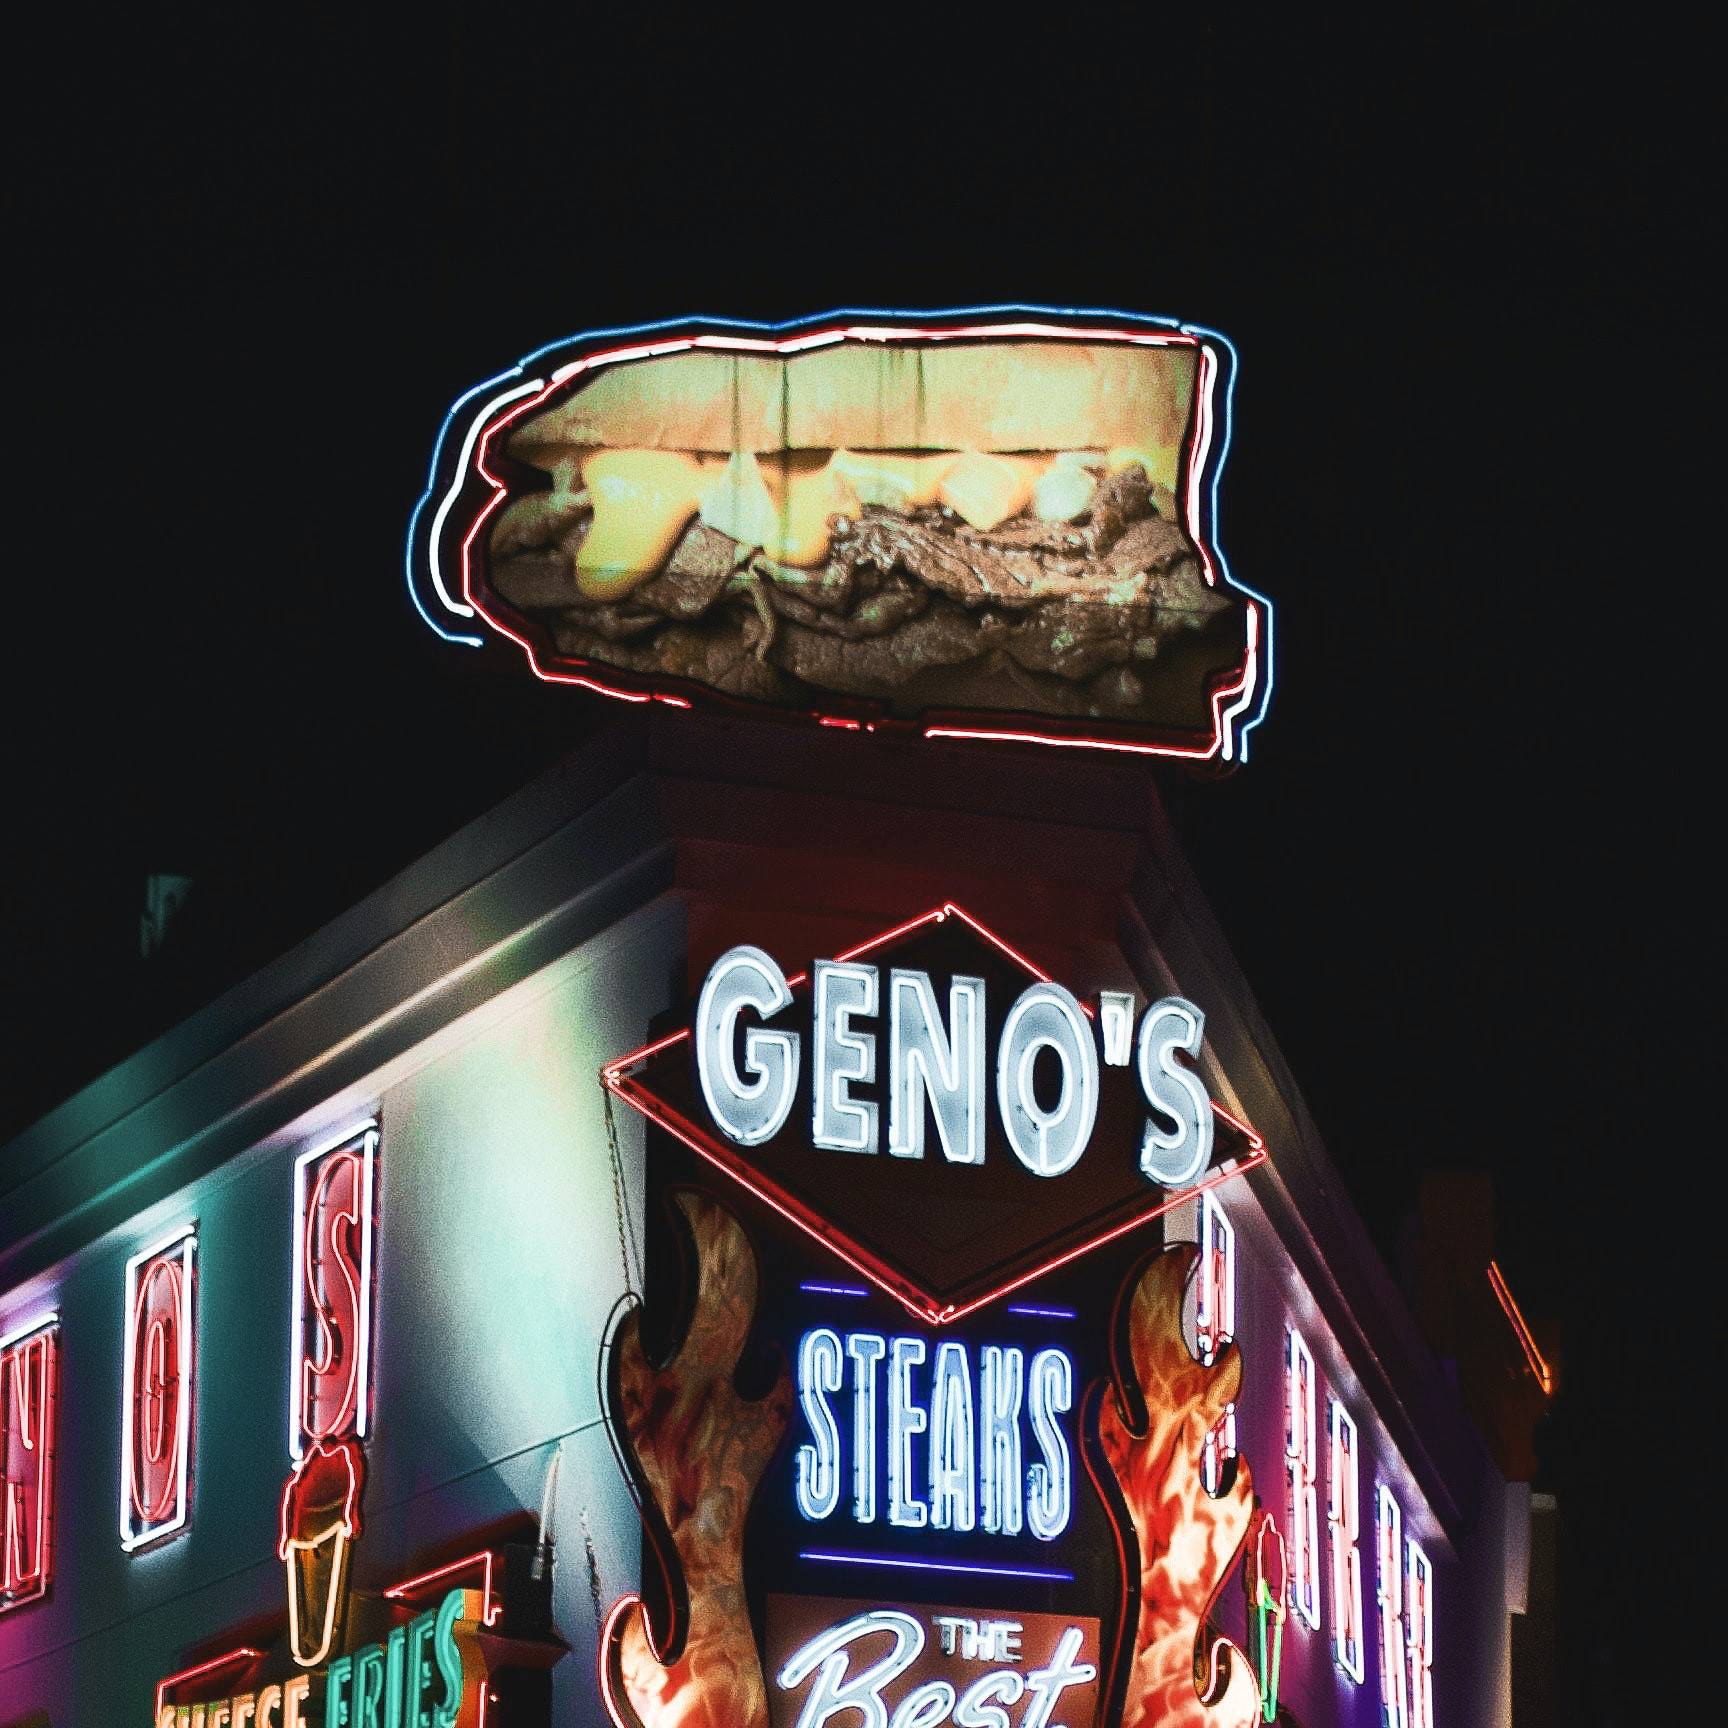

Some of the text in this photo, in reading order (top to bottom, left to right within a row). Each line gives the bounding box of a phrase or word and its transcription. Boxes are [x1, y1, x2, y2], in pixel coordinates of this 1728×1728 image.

[695, 944, 1214, 1190] GENO'S
[796, 1328, 1073, 1541] STEAKS
[932, 1612, 1024, 1662] THE
